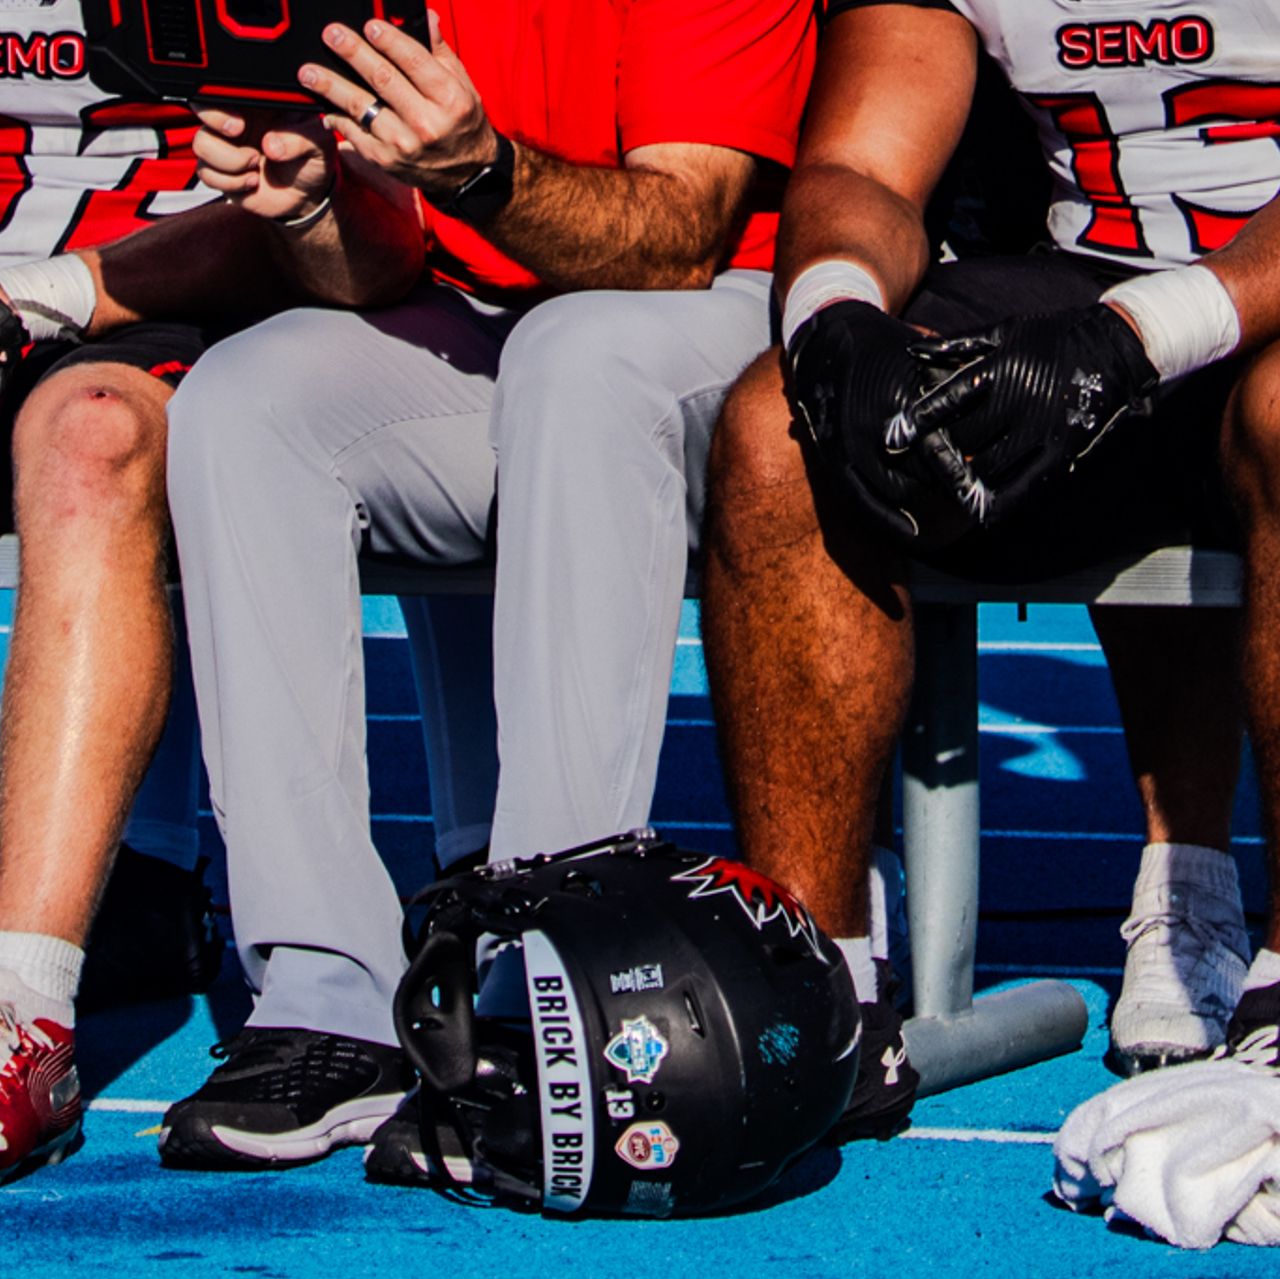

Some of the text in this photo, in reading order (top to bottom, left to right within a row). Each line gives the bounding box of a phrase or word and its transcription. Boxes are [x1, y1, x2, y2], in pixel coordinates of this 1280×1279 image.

[1056, 15, 1214, 69] SEMO
[533, 976, 583, 1200] BRICK BY BRICK
[606, 1089, 635, 1119] 13
